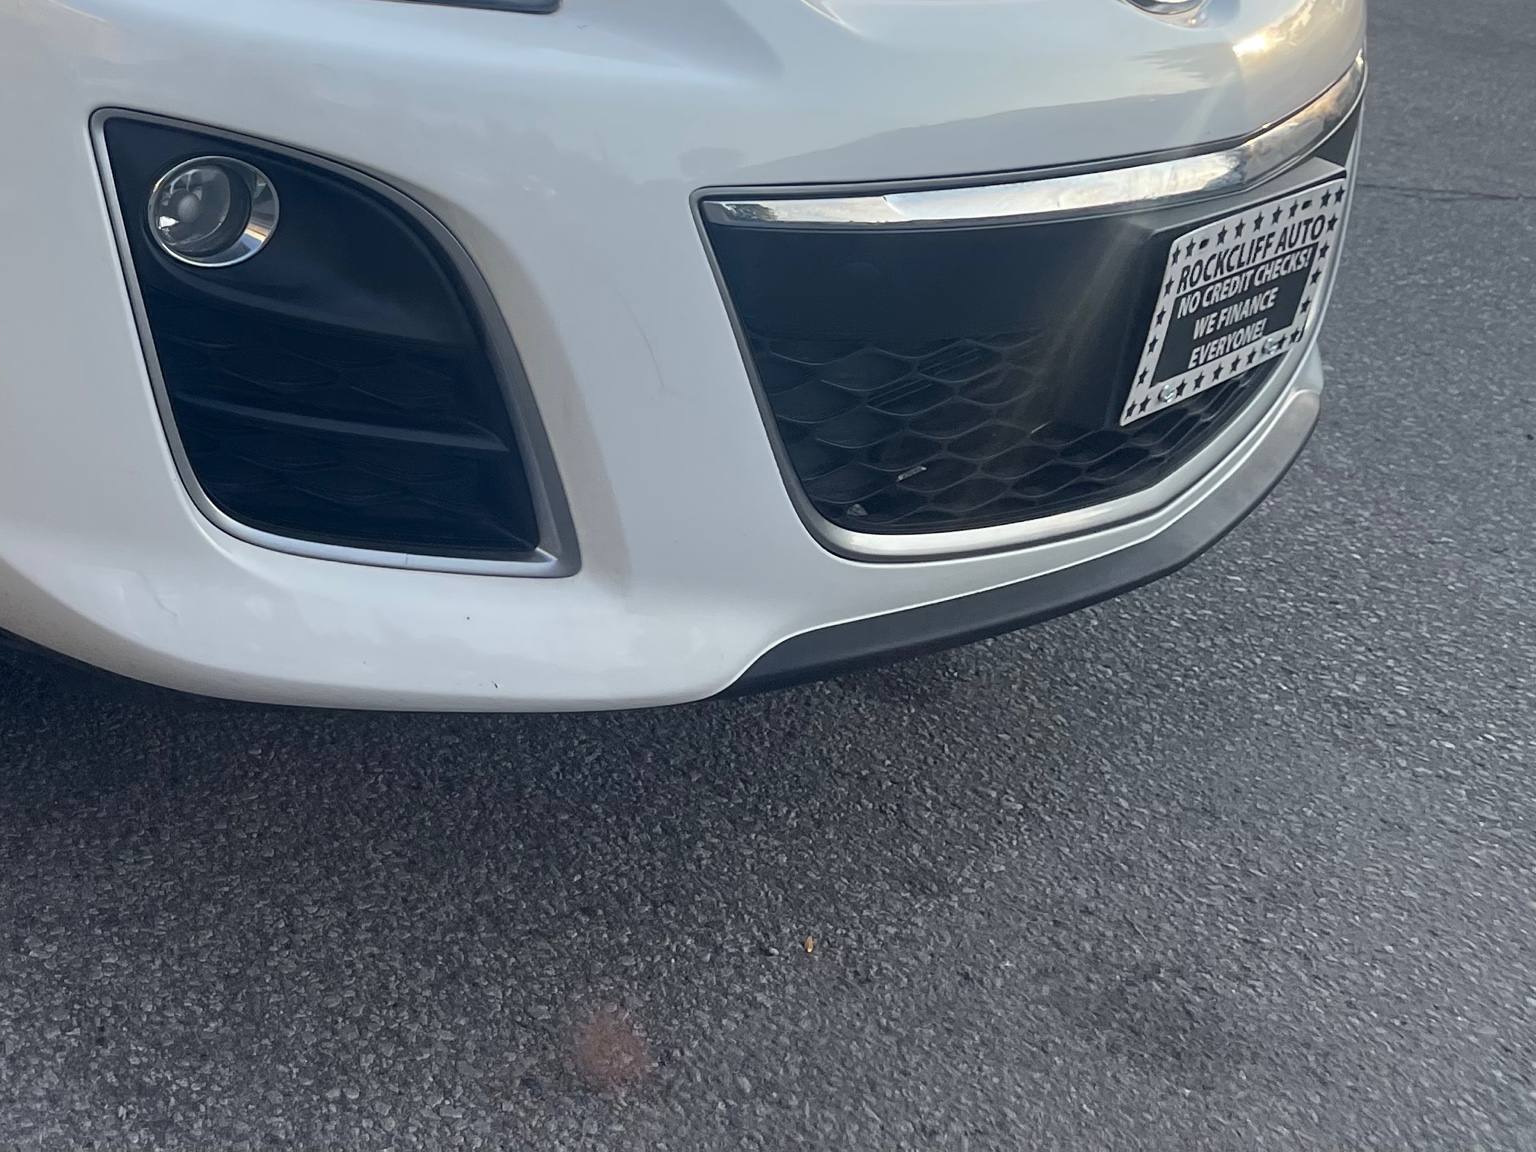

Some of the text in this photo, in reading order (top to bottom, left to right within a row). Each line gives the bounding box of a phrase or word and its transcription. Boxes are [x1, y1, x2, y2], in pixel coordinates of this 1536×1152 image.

[1177, 214, 1327, 294] ROCKCLIFF AUTO
[1177, 246, 1315, 319] NO CREDIT CHECKS!
[1187, 318, 1268, 371] EVERYONE!
[1192, 286, 1280, 341] WE FINANCE
